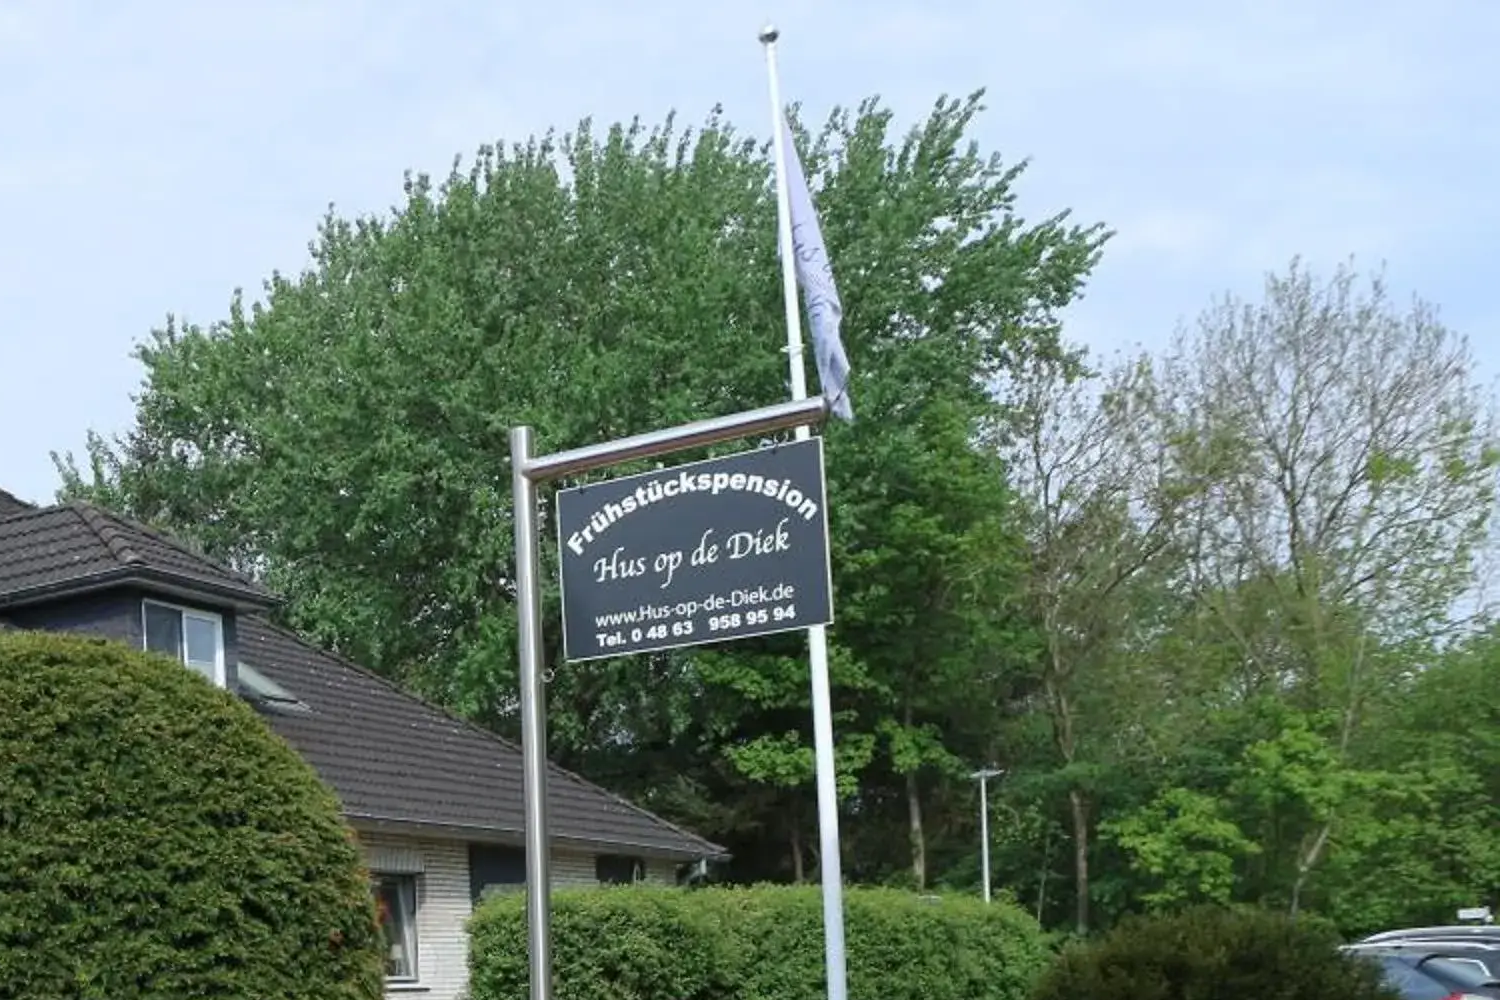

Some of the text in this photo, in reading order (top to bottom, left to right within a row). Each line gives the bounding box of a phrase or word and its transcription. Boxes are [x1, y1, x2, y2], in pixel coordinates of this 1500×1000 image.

[567, 471, 819, 555] Frühstückspension
[593, 518, 791, 589] Hus op de Diek
[595, 583, 795, 628] www.Hus-op-de-Diek.de
[596, 604, 796, 648] Tel. 0 48 63 958 95 94
